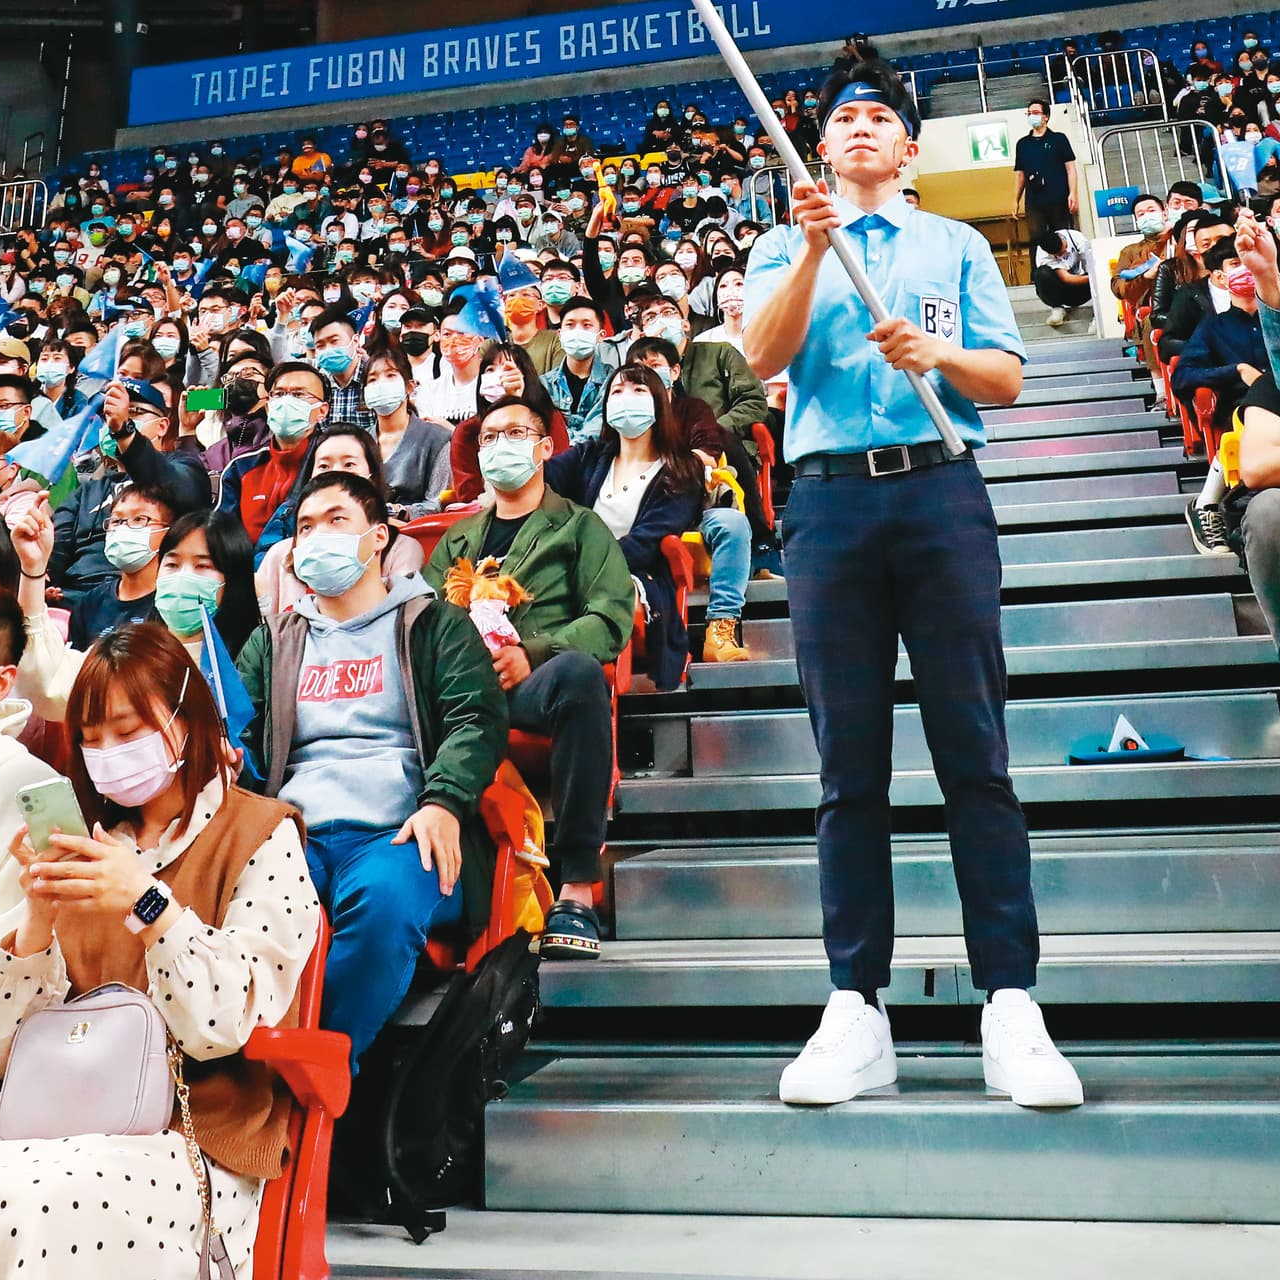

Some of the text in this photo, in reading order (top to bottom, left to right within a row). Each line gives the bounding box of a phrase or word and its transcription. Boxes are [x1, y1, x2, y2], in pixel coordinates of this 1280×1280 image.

[191, 1, 771, 106] TAIPEI FUBON BRAVES BASKETBLL
[925, 303, 936, 334] B
[344, 661, 380, 693] SHIT
